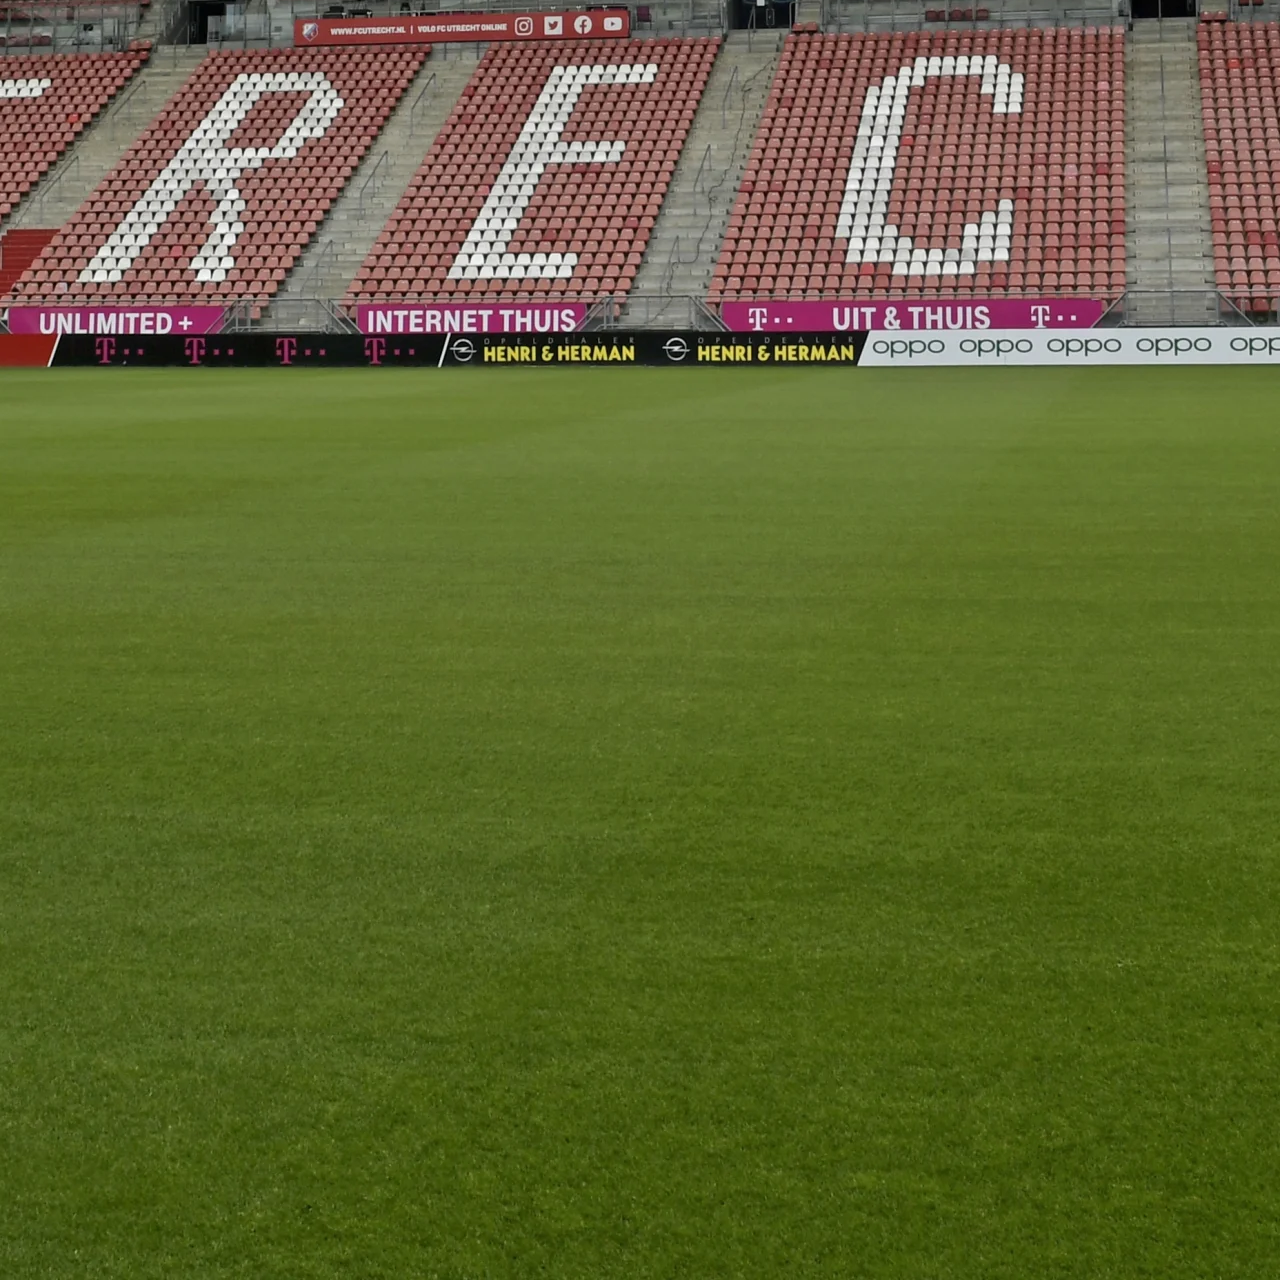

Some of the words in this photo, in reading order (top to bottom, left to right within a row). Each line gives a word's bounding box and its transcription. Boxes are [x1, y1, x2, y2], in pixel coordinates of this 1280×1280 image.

[446, 24, 480, 32] UTRECHT
[40, 312, 172, 334] UNLIMITED
[178, 316, 192, 330] +
[368, 310, 493, 332] INTERNET
[499, 310, 576, 332] THUIS
[832, 307, 876, 330] UIT
[884, 306, 901, 330] &
[908, 306, 990, 330] THUIS
[484, 346, 536, 362] HENRI
[542, 346, 554, 362] &
[558, 346, 634, 361] HERMAN
[698, 346, 752, 361] HENRI
[758, 346, 770, 361] &
[774, 345, 854, 361] HERMAN
[873, 339, 945, 358] oppo
[960, 338, 1033, 357] oppo
[1047, 338, 1122, 356] oppo
[1136, 337, 1212, 356] oppo
